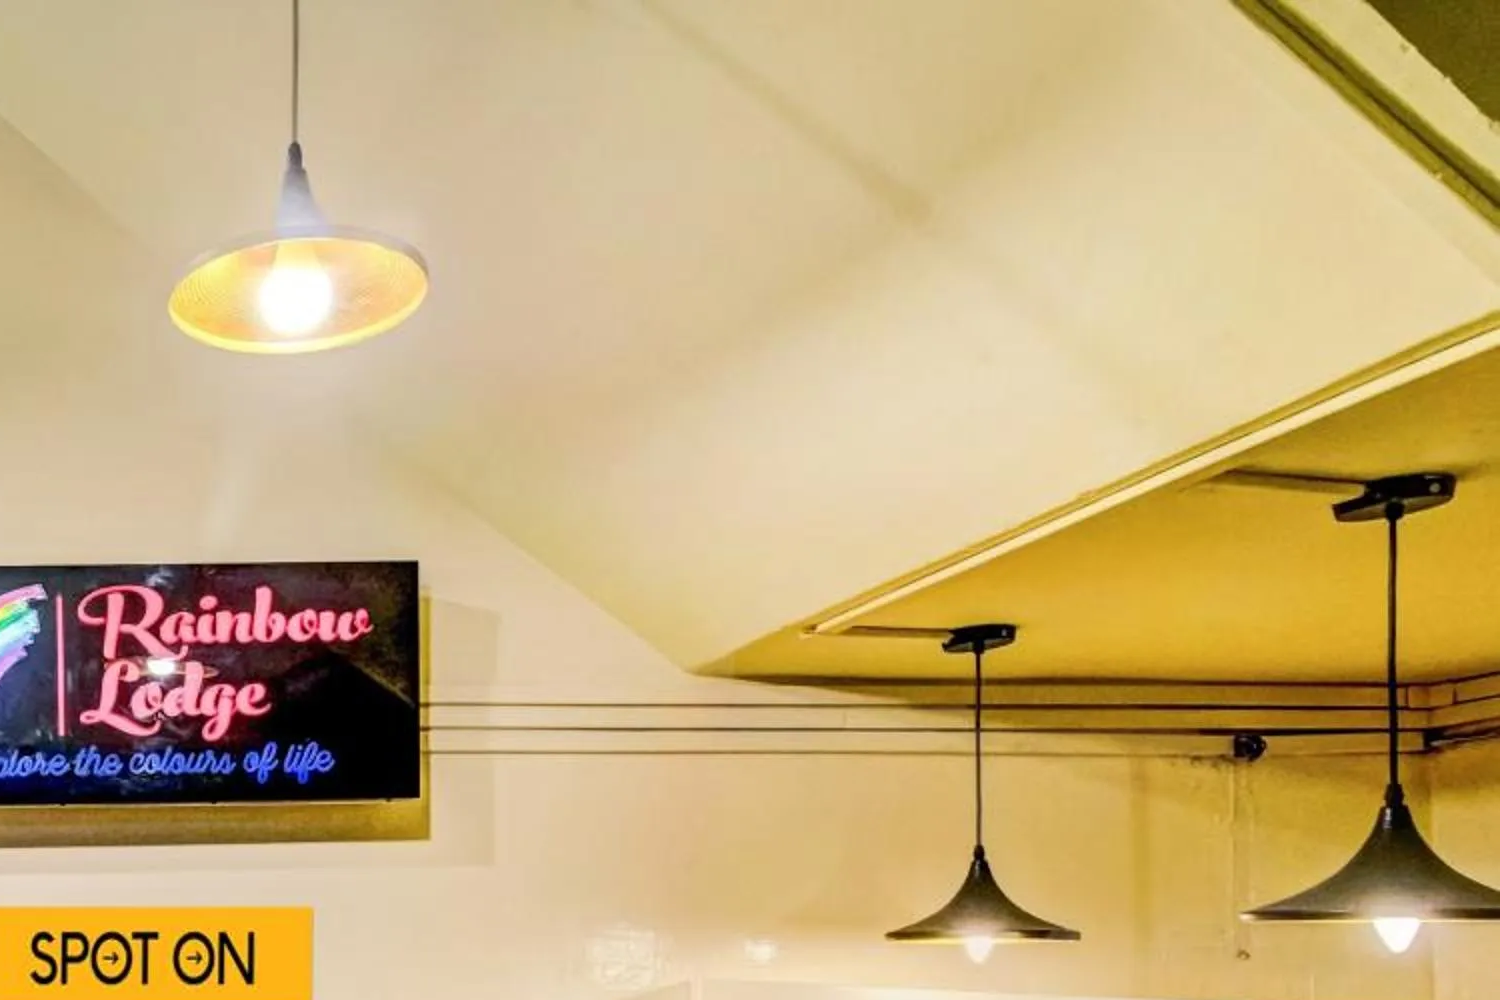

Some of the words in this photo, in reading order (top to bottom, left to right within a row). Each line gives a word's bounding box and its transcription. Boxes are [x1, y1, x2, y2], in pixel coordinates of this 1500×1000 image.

[78, 583, 373, 660] Rainbow
[79, 657, 272, 741] Lodge
[72, 745, 122, 776] the
[129, 744, 236, 776] colours
[242, 741, 278, 784] of
[283, 741, 335, 784] life
[29, 931, 159, 986] SPOT
[172, 931, 255, 986] ON
